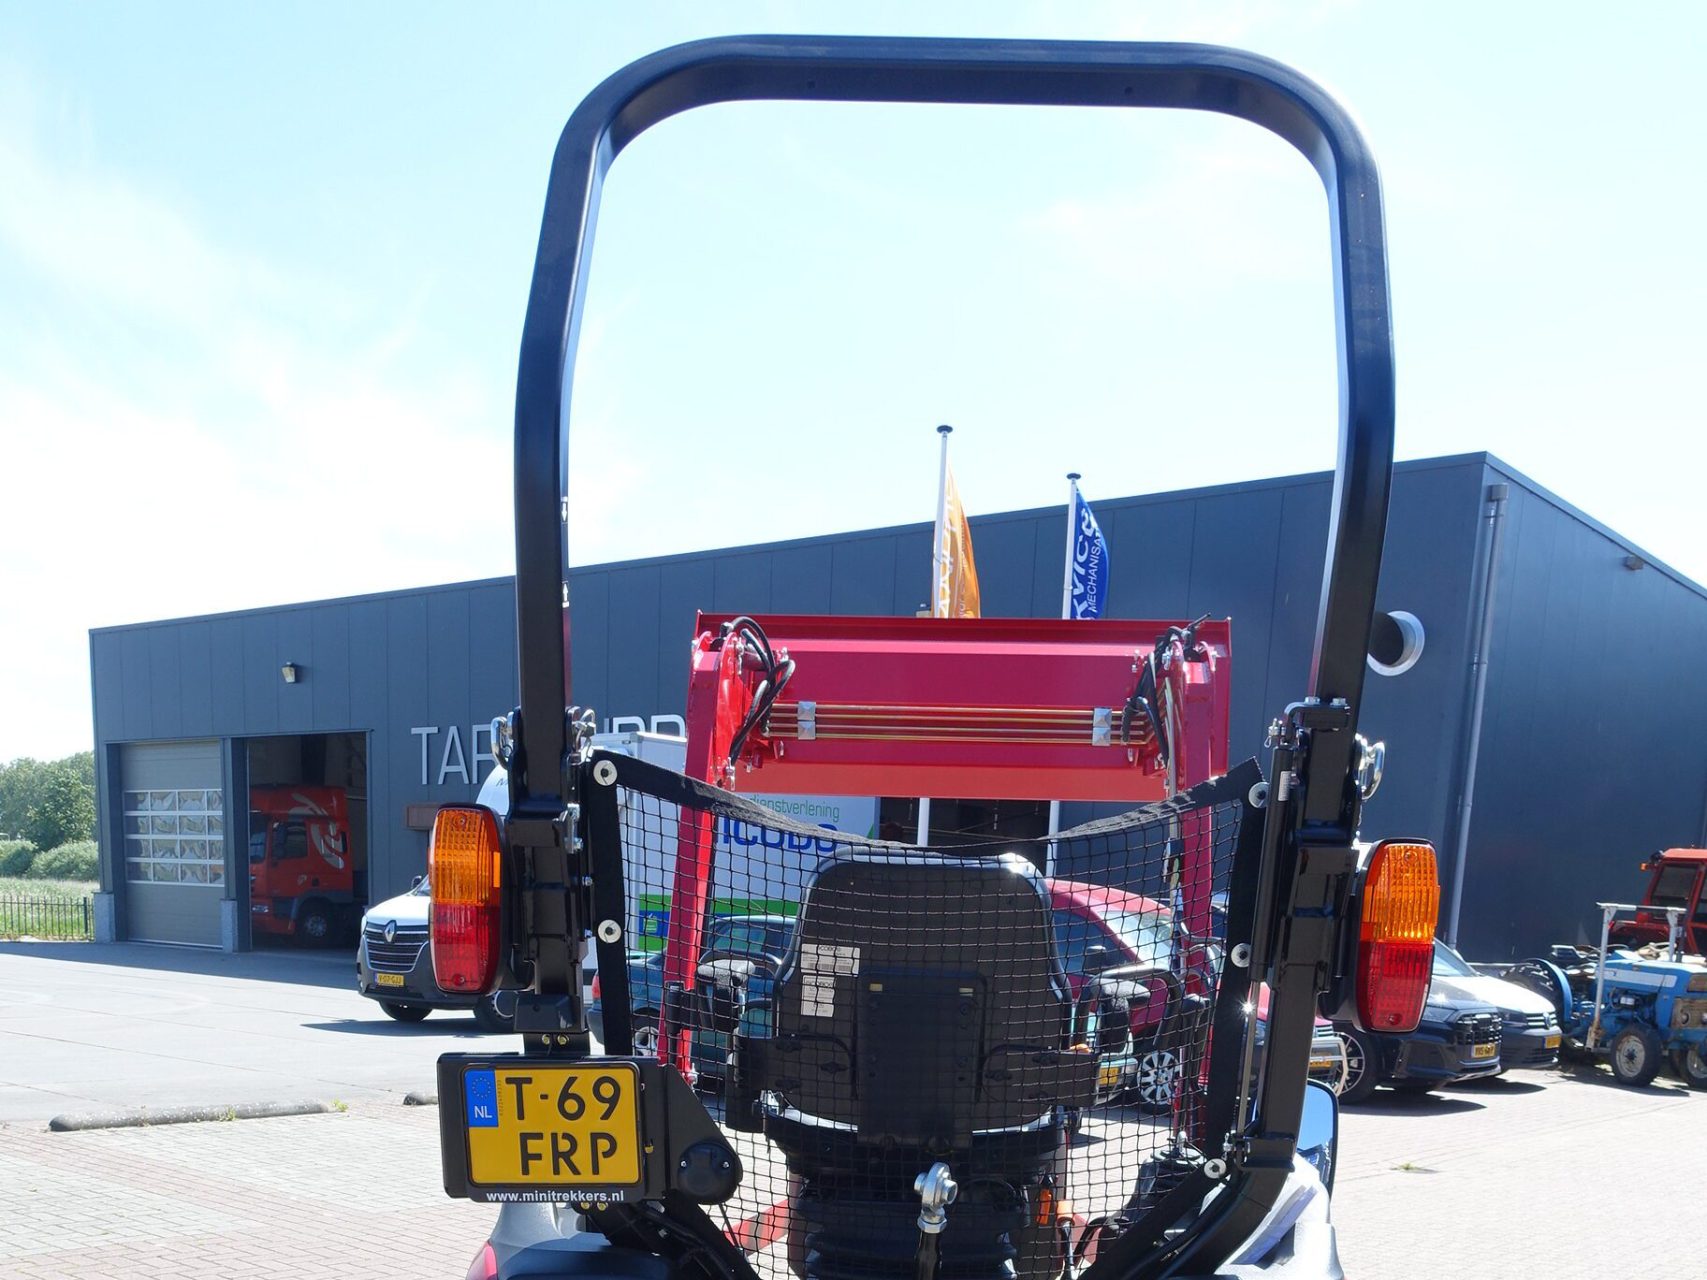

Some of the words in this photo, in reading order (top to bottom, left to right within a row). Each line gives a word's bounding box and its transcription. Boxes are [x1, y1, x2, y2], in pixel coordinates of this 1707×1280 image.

[474, 1105, 493, 1119] NL
[505, 1076, 621, 1121] T-69
[519, 1132, 618, 1176] FRP
[486, 1190, 625, 1203] www.minitrekkers.nl
